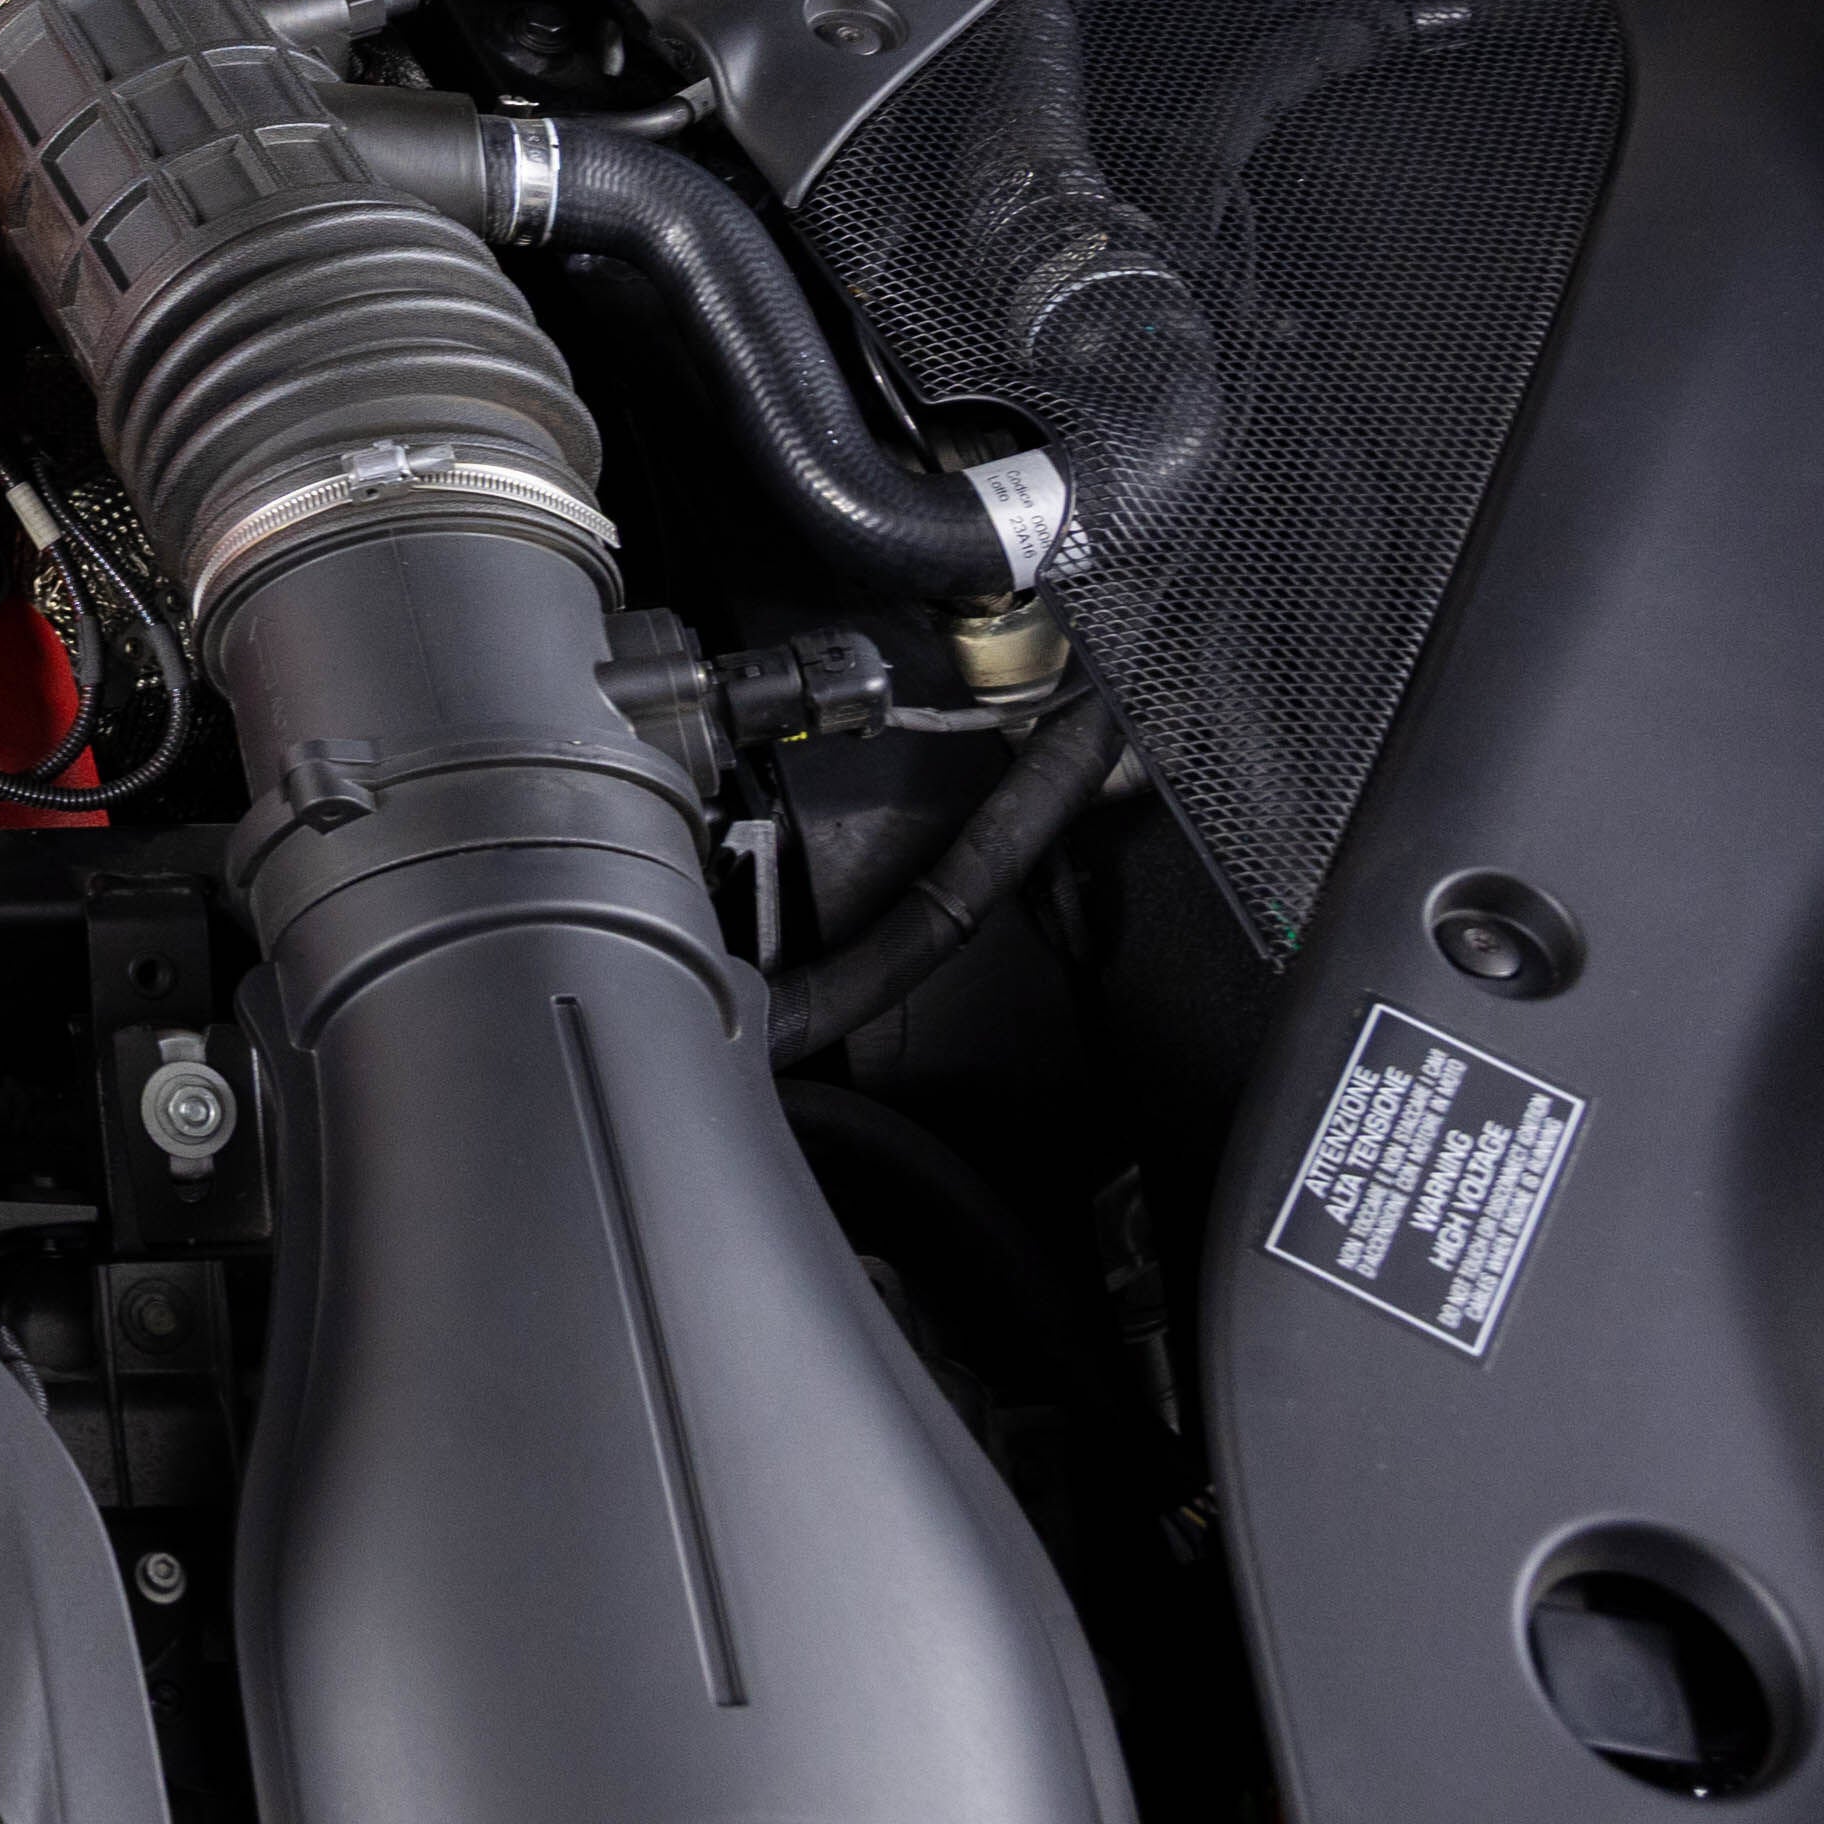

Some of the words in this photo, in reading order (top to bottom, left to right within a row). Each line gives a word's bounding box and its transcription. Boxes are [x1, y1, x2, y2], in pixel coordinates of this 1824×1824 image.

[1006, 470, 1033, 509] Codice
[1303, 1065, 1379, 1197] ATTENZIONE
[1323, 1168, 1365, 1223] ALTA
[1346, 1066, 1411, 1172] TENSIONE
[1409, 1128, 1474, 1233] WARNING
[1428, 1211, 1471, 1270] HIGH
[1452, 1120, 1511, 1214] VOLTAGE
